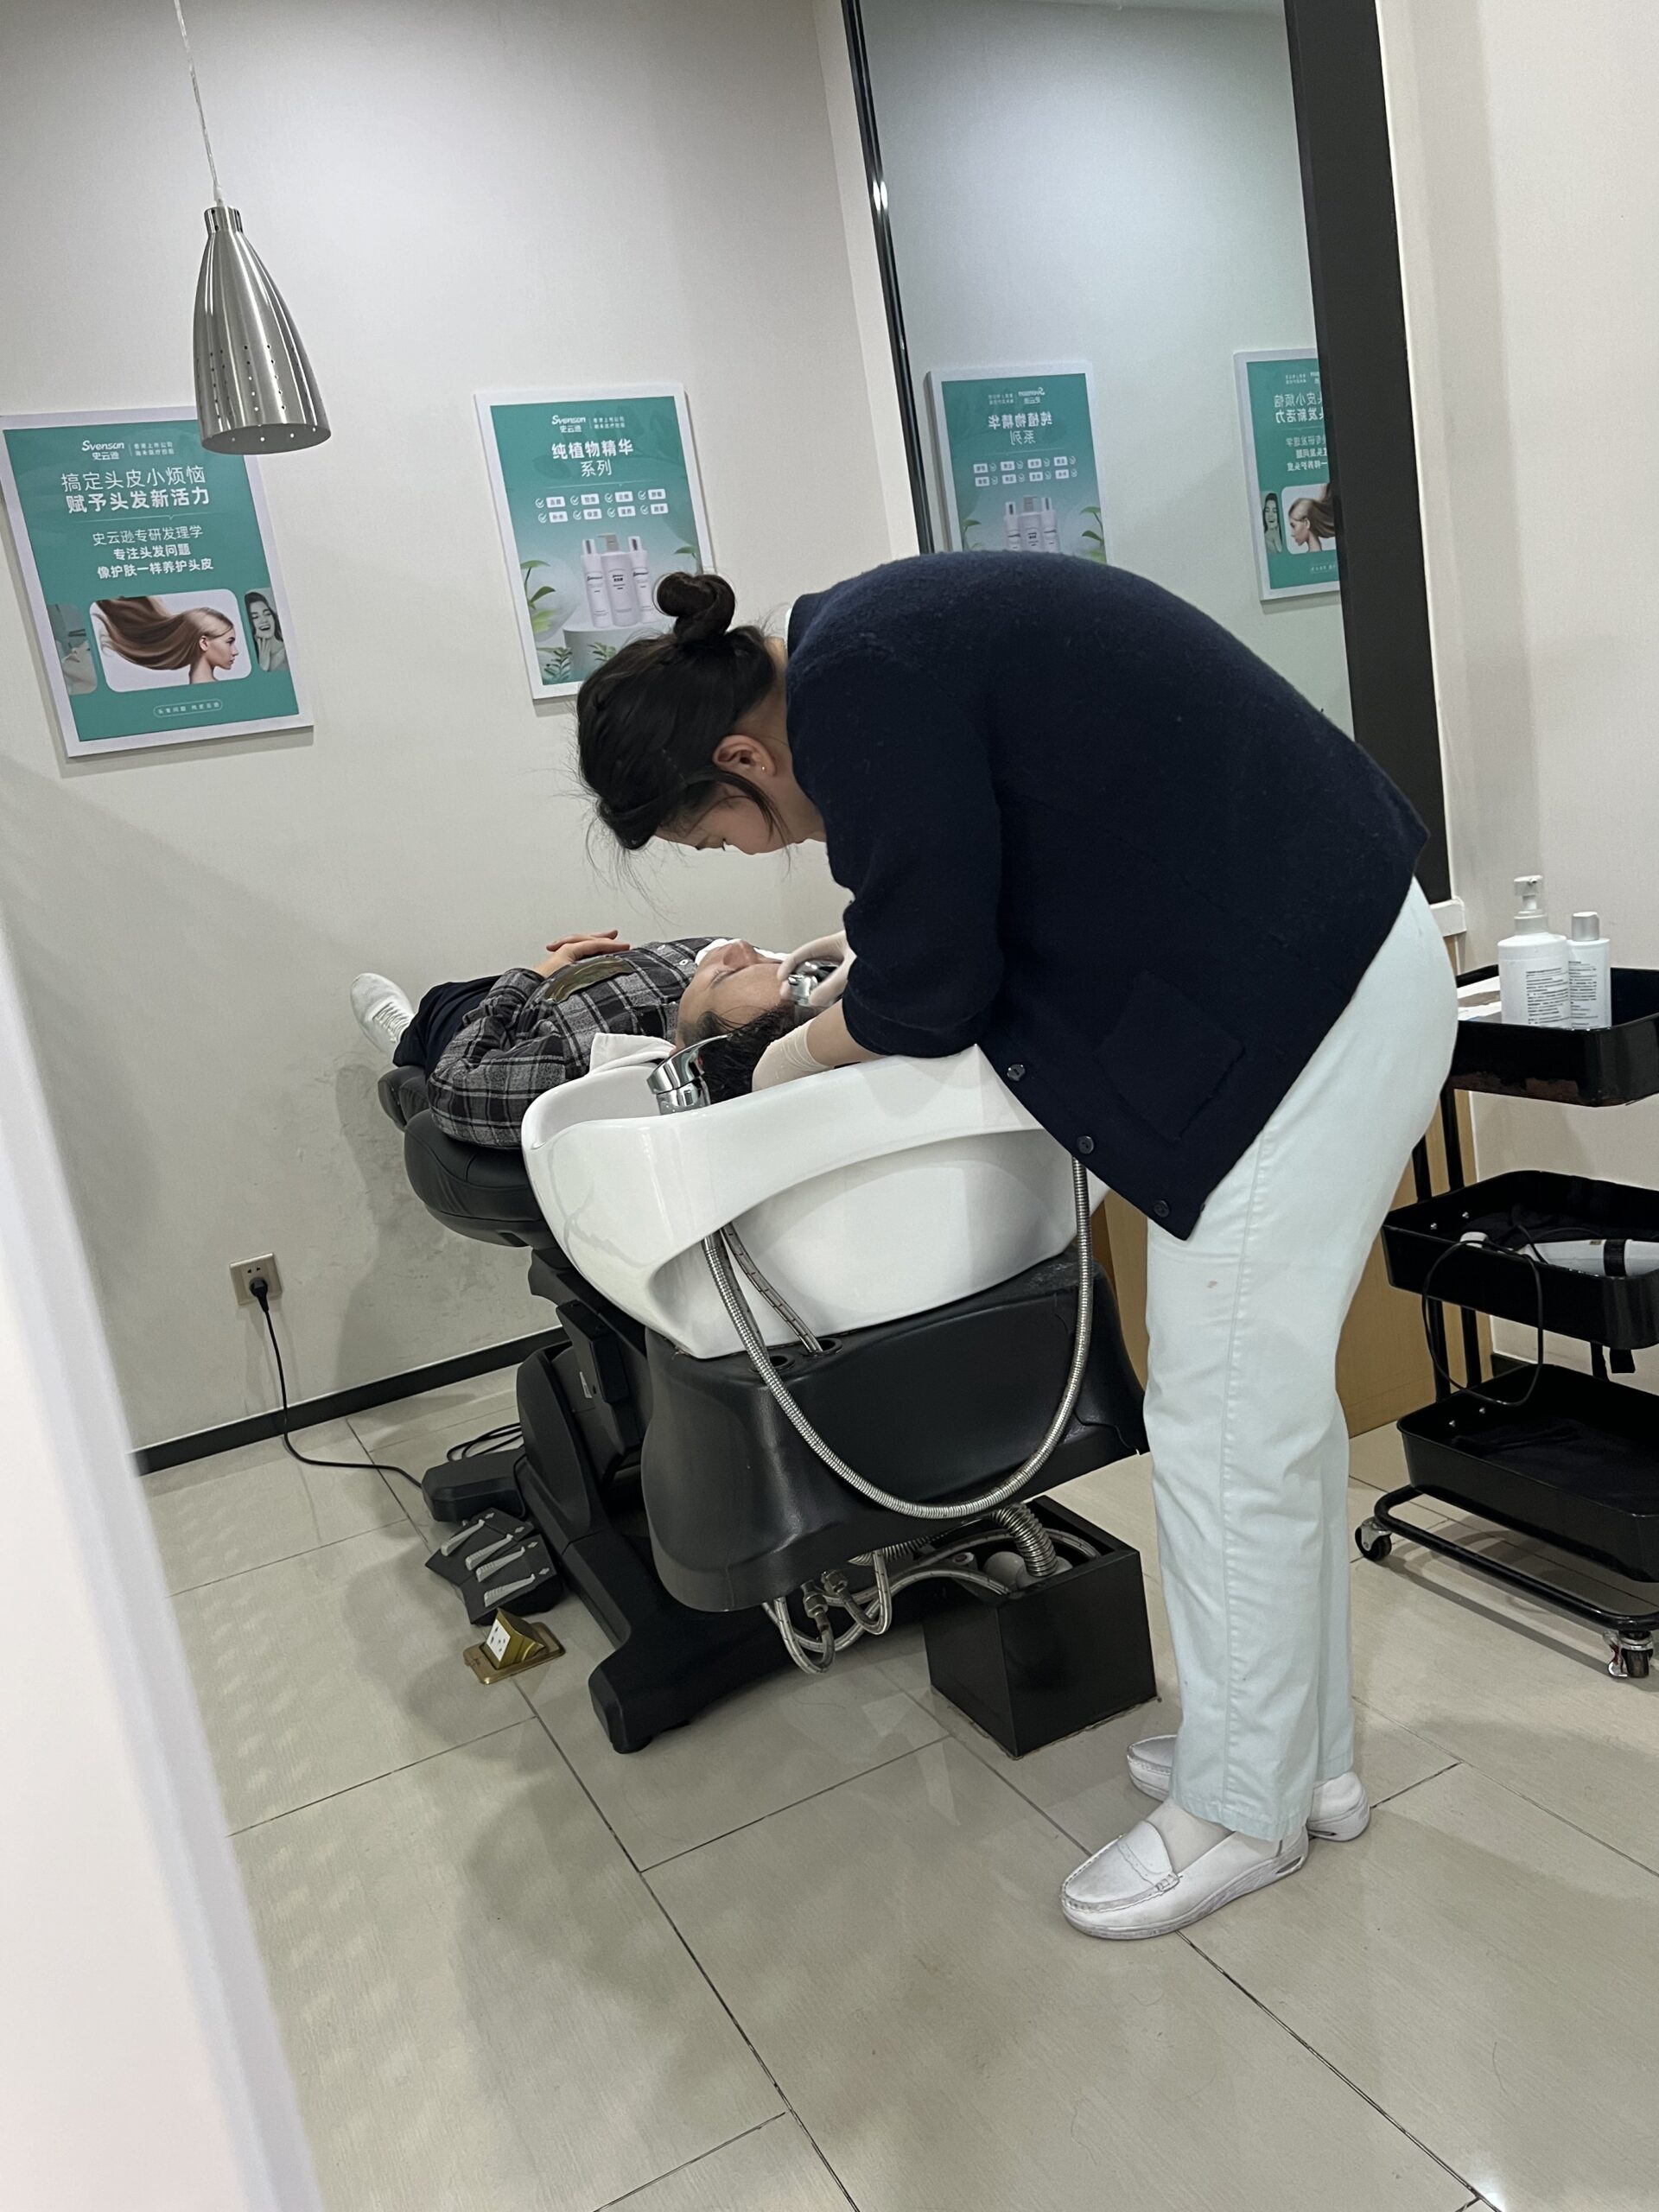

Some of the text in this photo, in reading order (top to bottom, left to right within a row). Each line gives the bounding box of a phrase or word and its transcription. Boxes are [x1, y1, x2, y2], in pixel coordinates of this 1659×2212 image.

[81, 440, 125, 452] Svenson
[551, 438, 634, 460] 纯植物精华
[580, 458, 613, 477] 系列
[60, 465, 207, 493] 搞定头皮小烦恼
[66, 486, 210, 514] 赋予头发新活力
[92, 524, 204, 546] 史云逊专研发理学
[113, 543, 192, 561] 专注头发问题
[97, 557, 214, 580] 像护肤一样养护头皮
